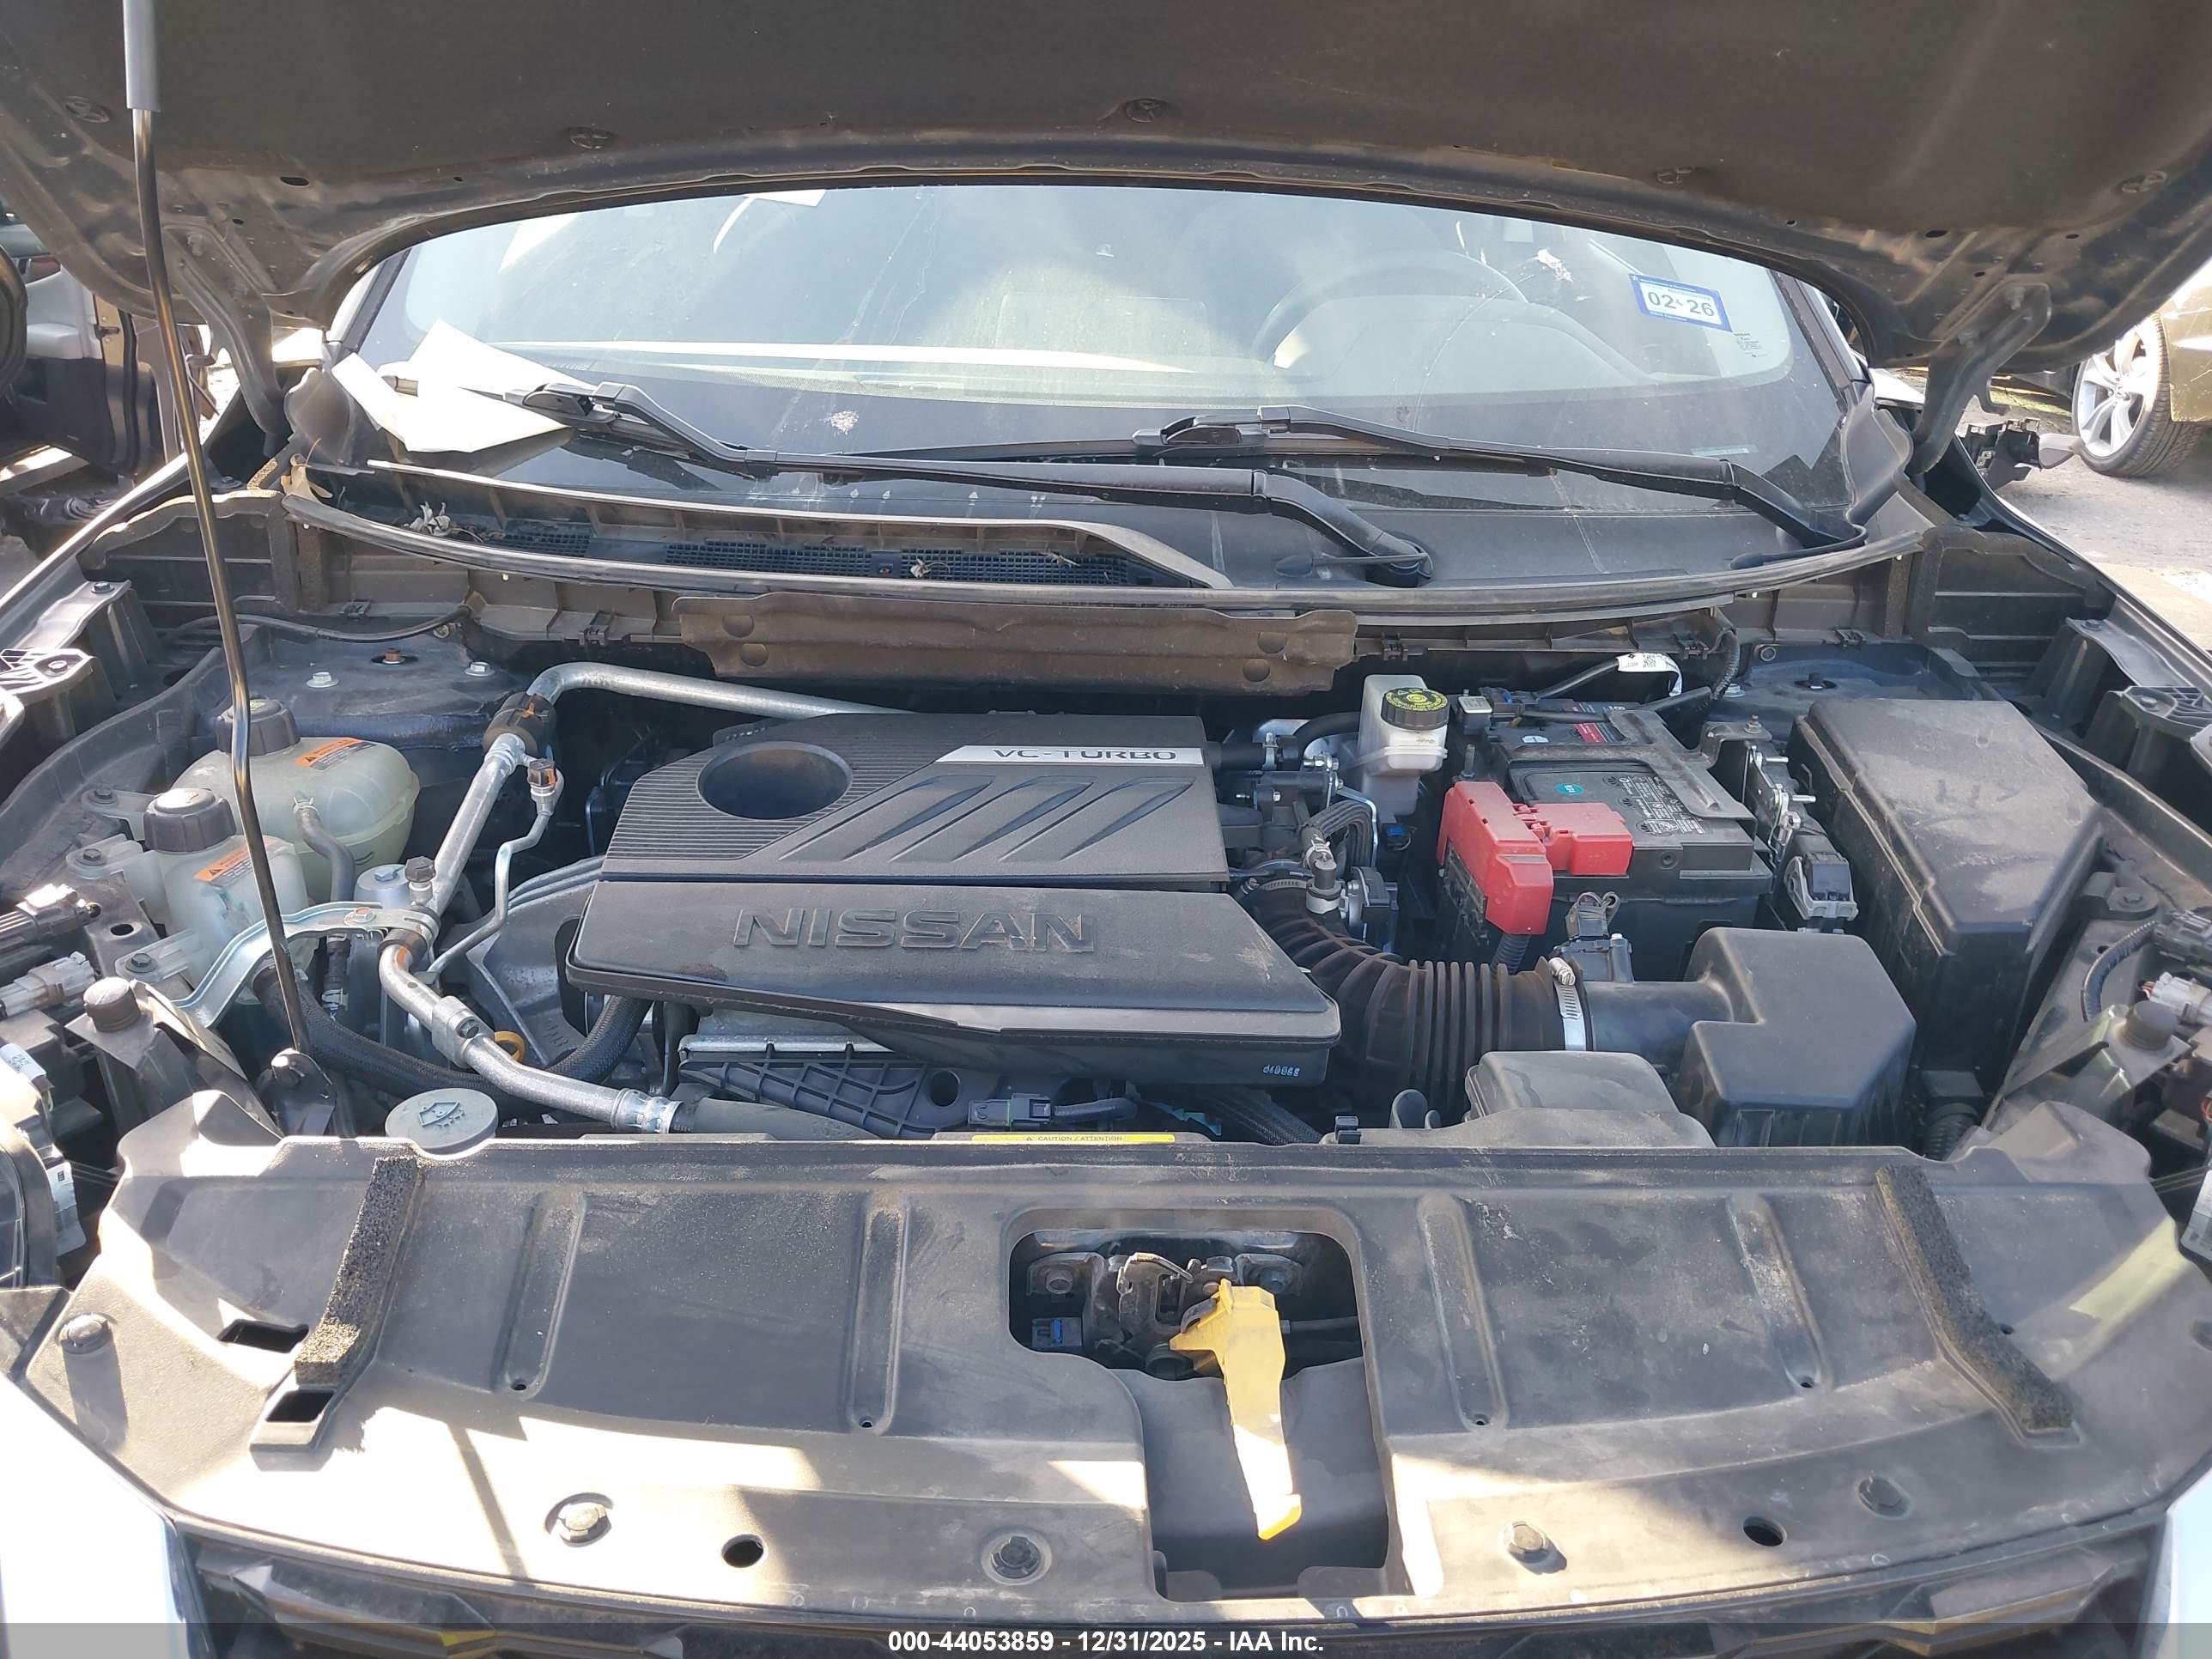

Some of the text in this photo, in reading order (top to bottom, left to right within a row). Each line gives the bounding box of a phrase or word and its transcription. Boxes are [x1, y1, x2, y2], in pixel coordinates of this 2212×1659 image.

[1648, 291, 1677, 310] 02
[1686, 299, 1716, 317] 26
[732, 908, 1097, 953] NISSAN
